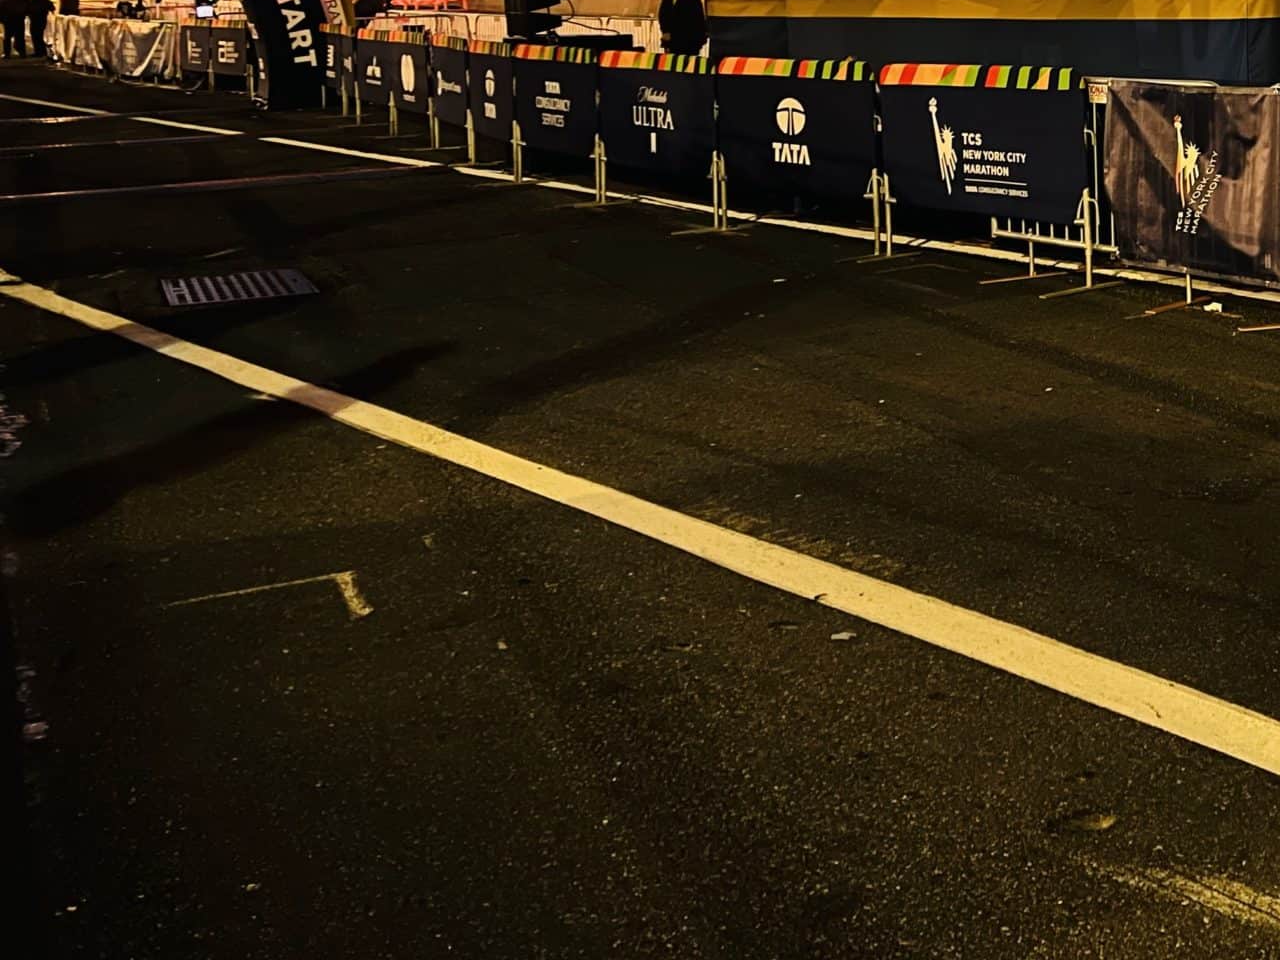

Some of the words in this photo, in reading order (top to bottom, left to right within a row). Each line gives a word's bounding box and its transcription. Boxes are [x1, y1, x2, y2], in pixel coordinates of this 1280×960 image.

[632, 105, 675, 131] ULTRA
[961, 132, 982, 146] TCS
[771, 141, 811, 166] TATA
[962, 149, 982, 160] NEW
[982, 150, 1006, 162] YORK
[1006, 152, 1026, 164] CITY
[963, 163, 1010, 177] MARATHON
[1183, 207, 1193, 233] NEW
[1188, 176, 1209, 206] YORK
[1206, 150, 1219, 175] CITY
[1190, 173, 1222, 234] MARATHON
[1175, 211, 1184, 232] TCS
